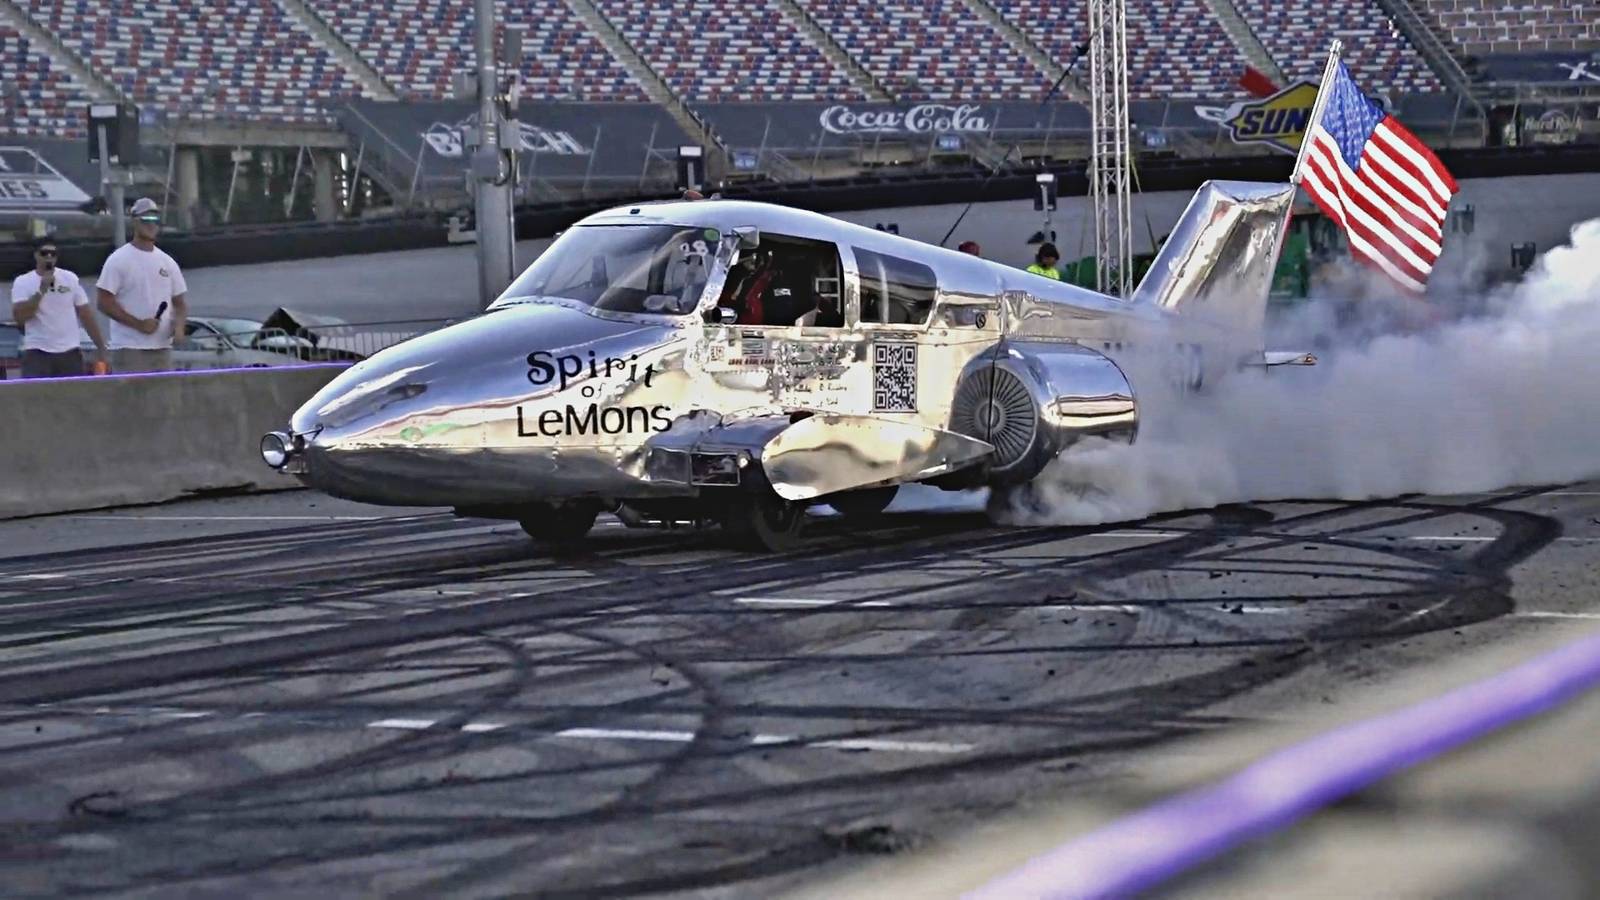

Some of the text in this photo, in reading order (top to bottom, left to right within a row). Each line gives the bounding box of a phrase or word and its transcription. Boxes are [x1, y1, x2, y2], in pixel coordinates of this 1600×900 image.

[819, 104, 990, 134] Coca-Cola
[1240, 109, 1311, 135] SUN
[527, 350, 658, 392] Spirit
[581, 382, 607, 399] of
[516, 403, 673, 437] LeMons
